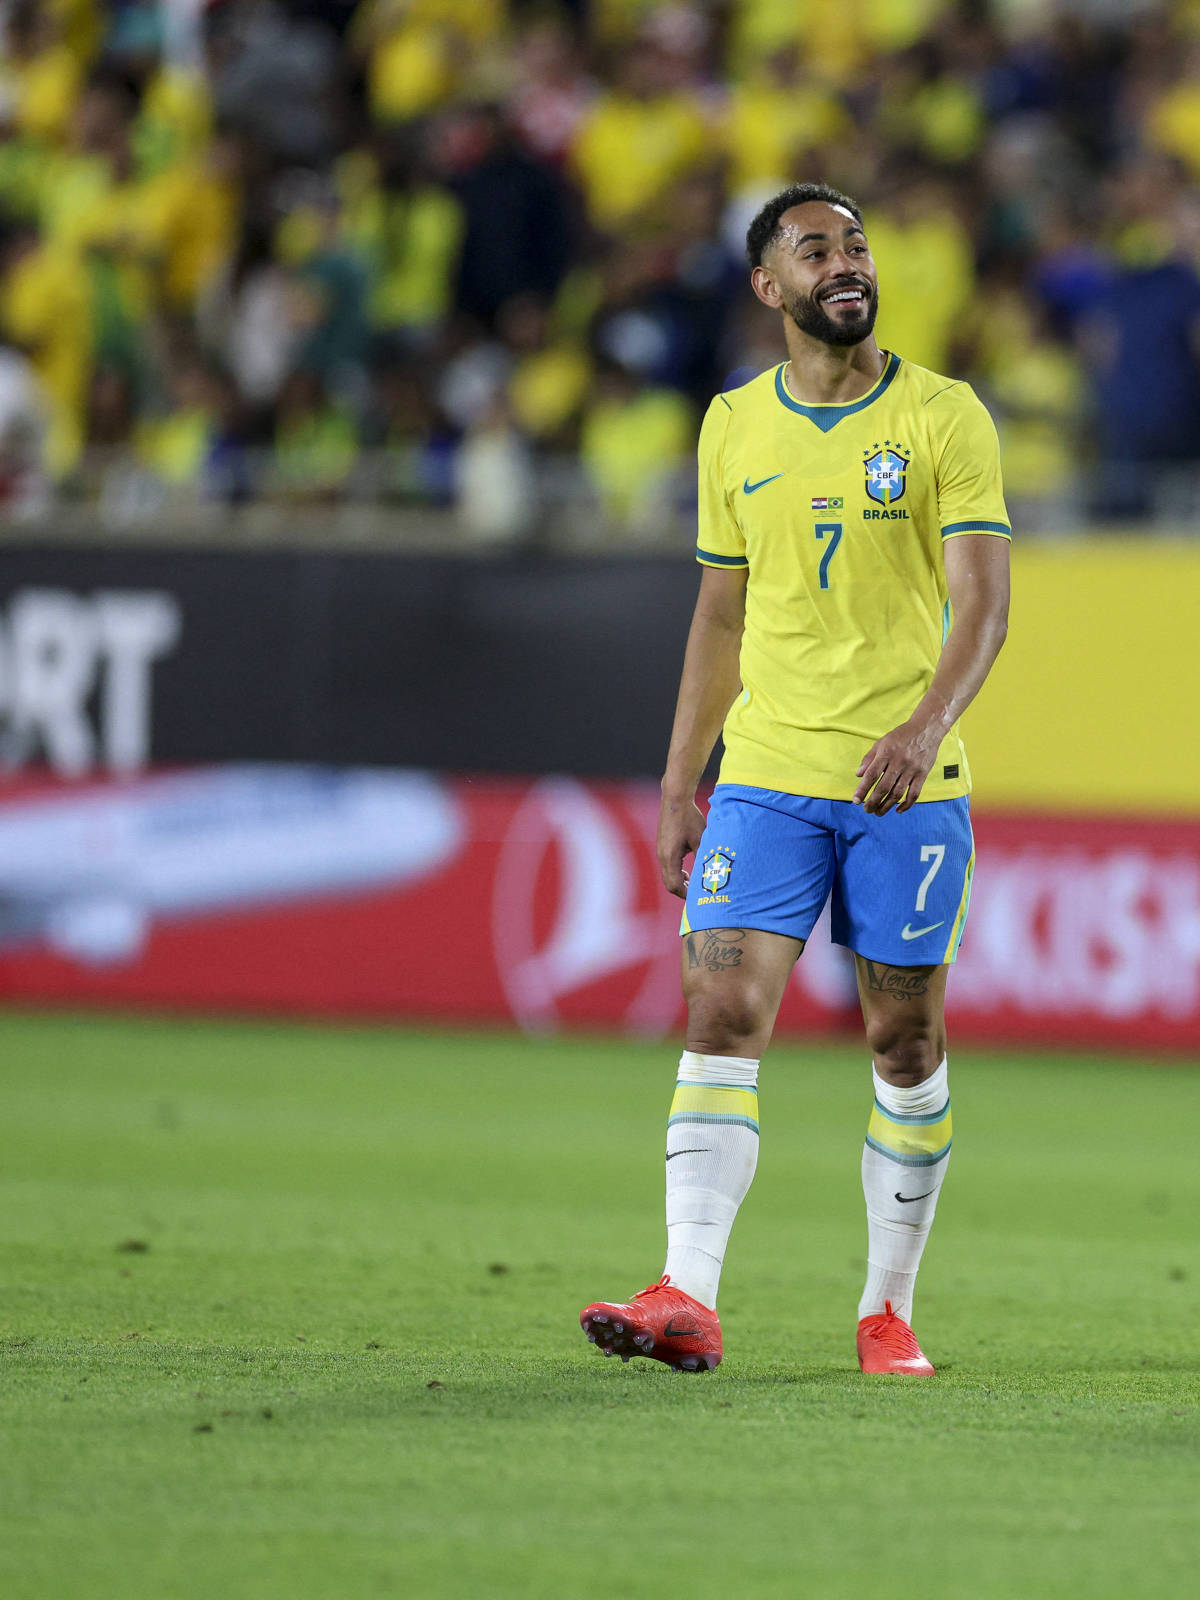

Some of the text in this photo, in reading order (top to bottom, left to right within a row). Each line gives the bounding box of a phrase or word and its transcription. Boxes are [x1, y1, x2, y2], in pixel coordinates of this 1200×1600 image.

[876, 471, 894, 480] CBF
[863, 509, 910, 520] BRASIL
[814, 522, 844, 590] 7
[0, 588, 182, 776] RT
[914, 843, 946, 912] 7
[697, 895, 732, 906] BRASIL
